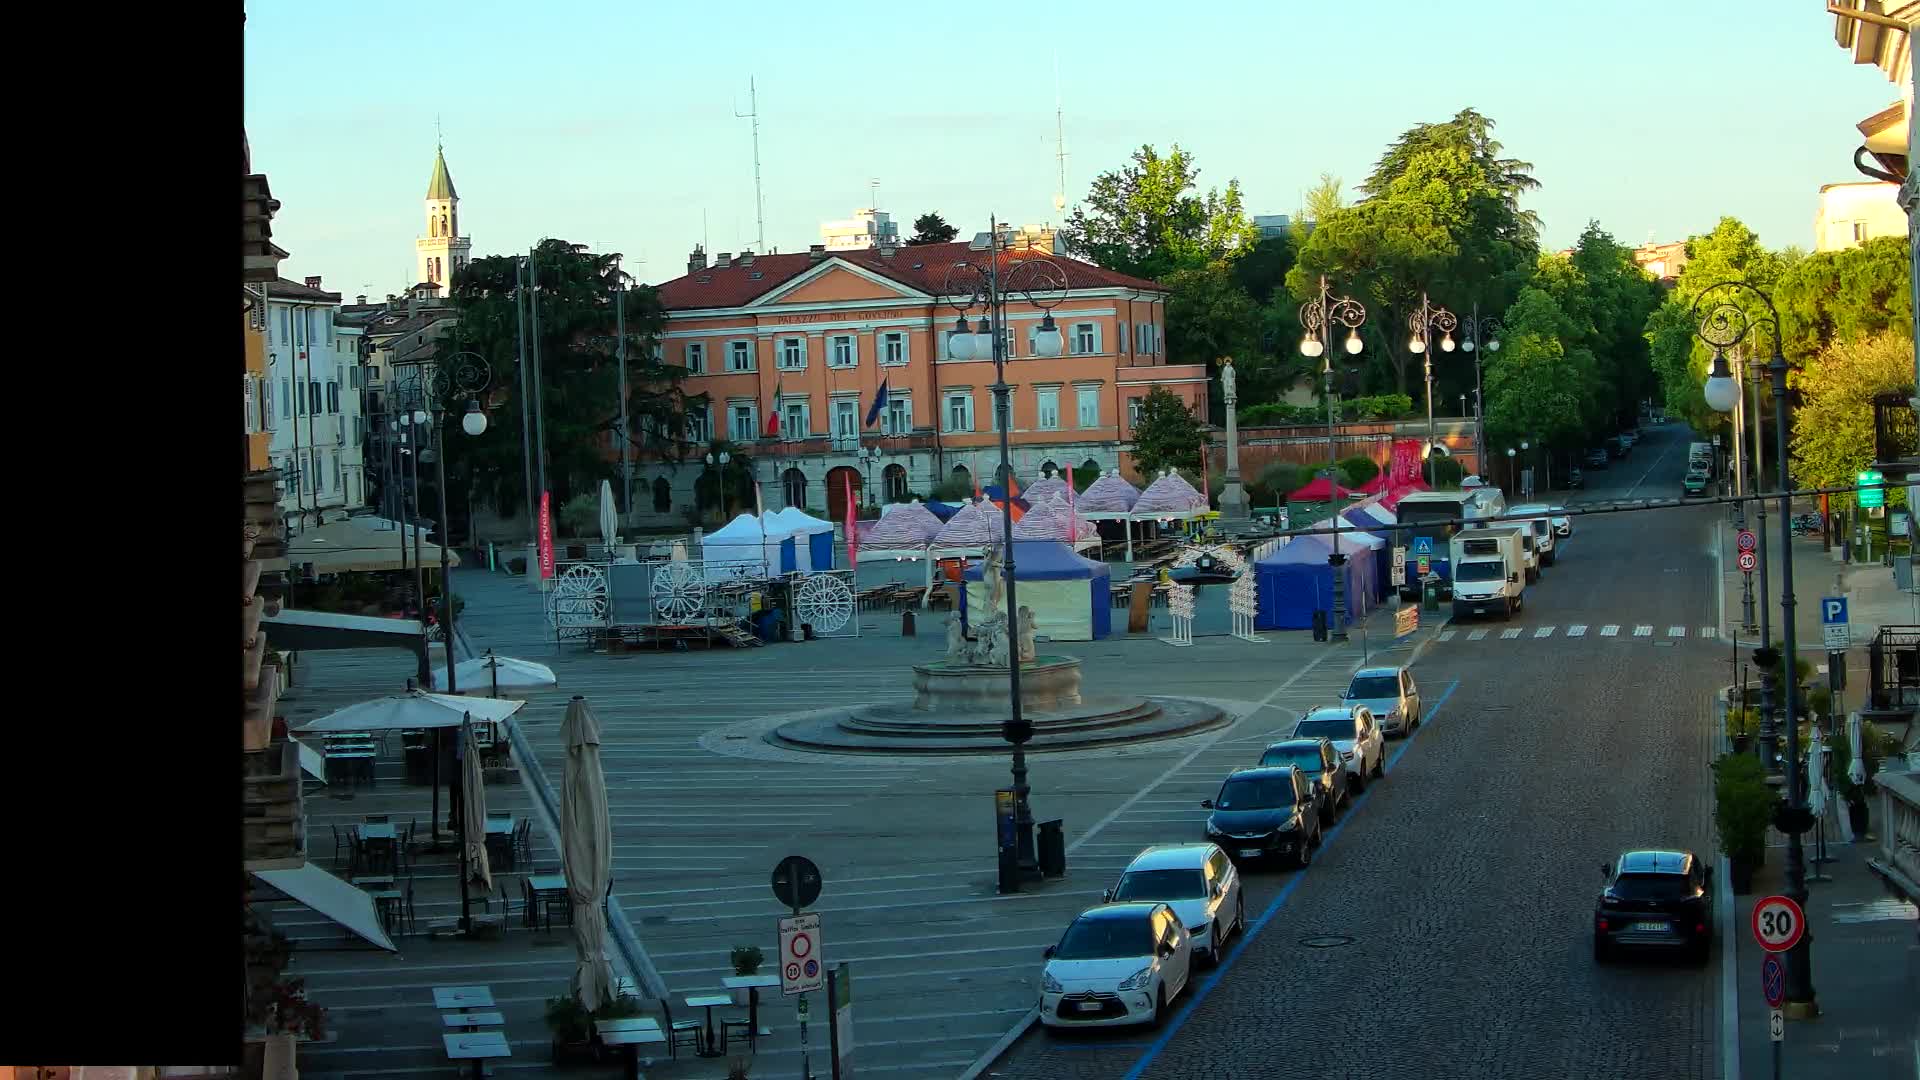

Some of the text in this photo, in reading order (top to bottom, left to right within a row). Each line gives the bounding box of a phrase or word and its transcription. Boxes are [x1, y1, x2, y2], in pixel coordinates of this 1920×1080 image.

[1742, 556, 1753, 566] 20
[1827, 602, 1842, 621] P
[1762, 911, 1792, 937] 30
[789, 967, 798, 977] 20
